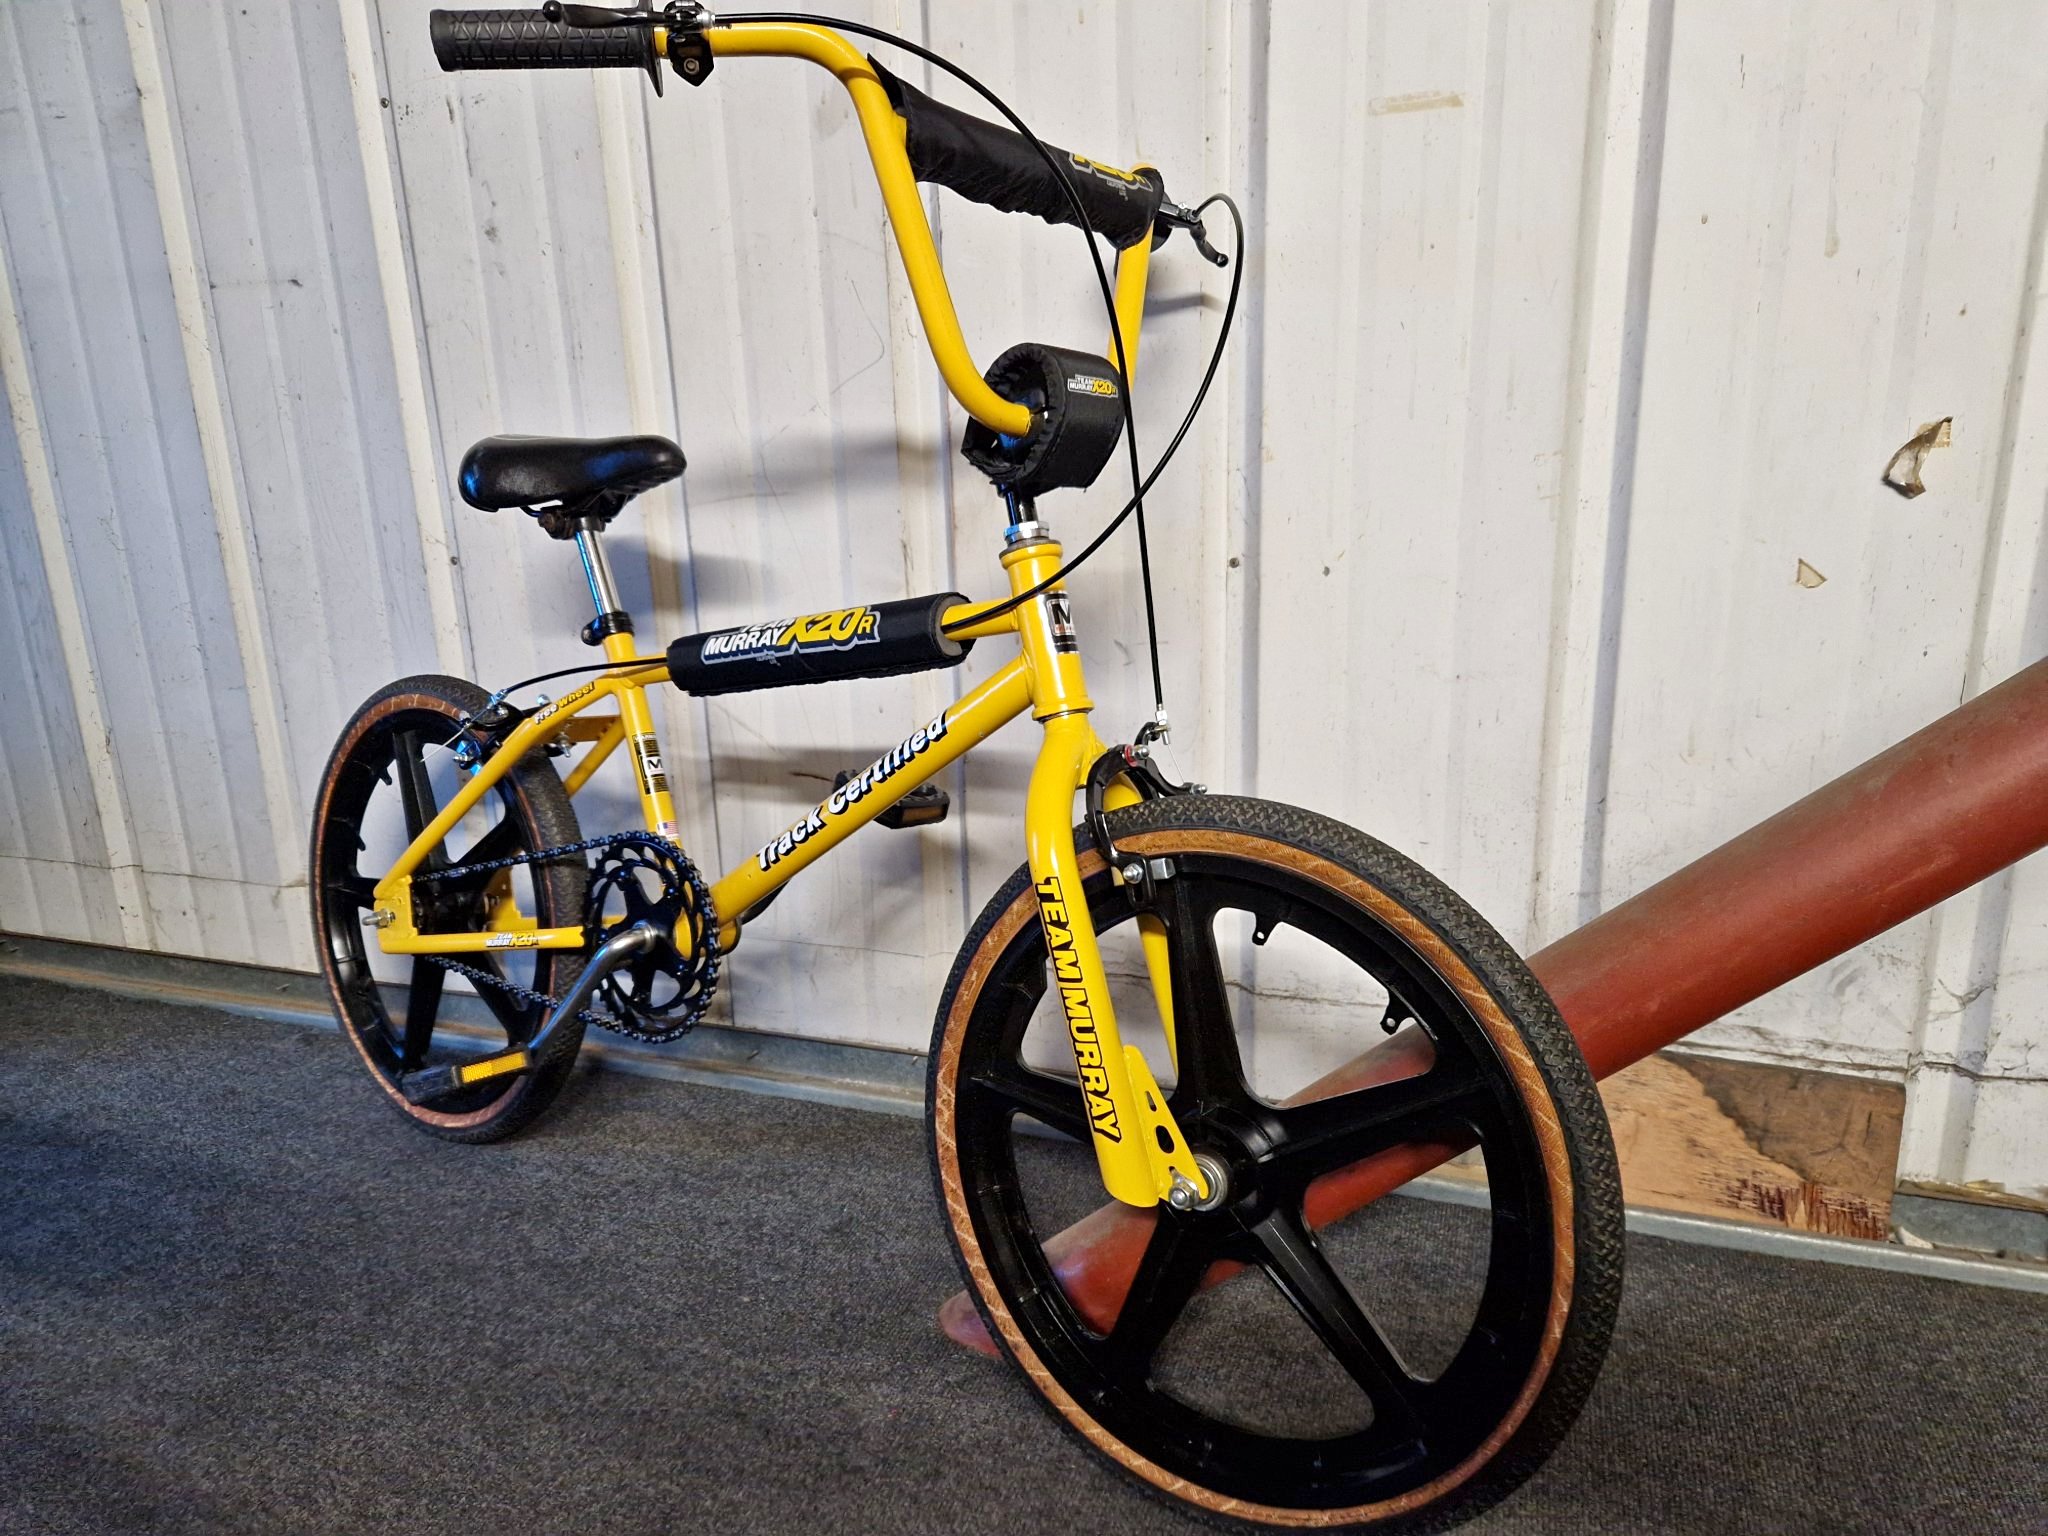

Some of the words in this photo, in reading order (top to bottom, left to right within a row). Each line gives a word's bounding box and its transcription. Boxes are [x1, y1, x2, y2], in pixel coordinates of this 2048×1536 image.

[704, 626, 788, 656] MURRAY
[558, 681, 596, 708] Wheel
[756, 805, 827, 872] Track
[827, 709, 948, 815] Certified
[1036, 876, 1083, 984] TEAM
[1060, 987, 1122, 1144] MURRAY
